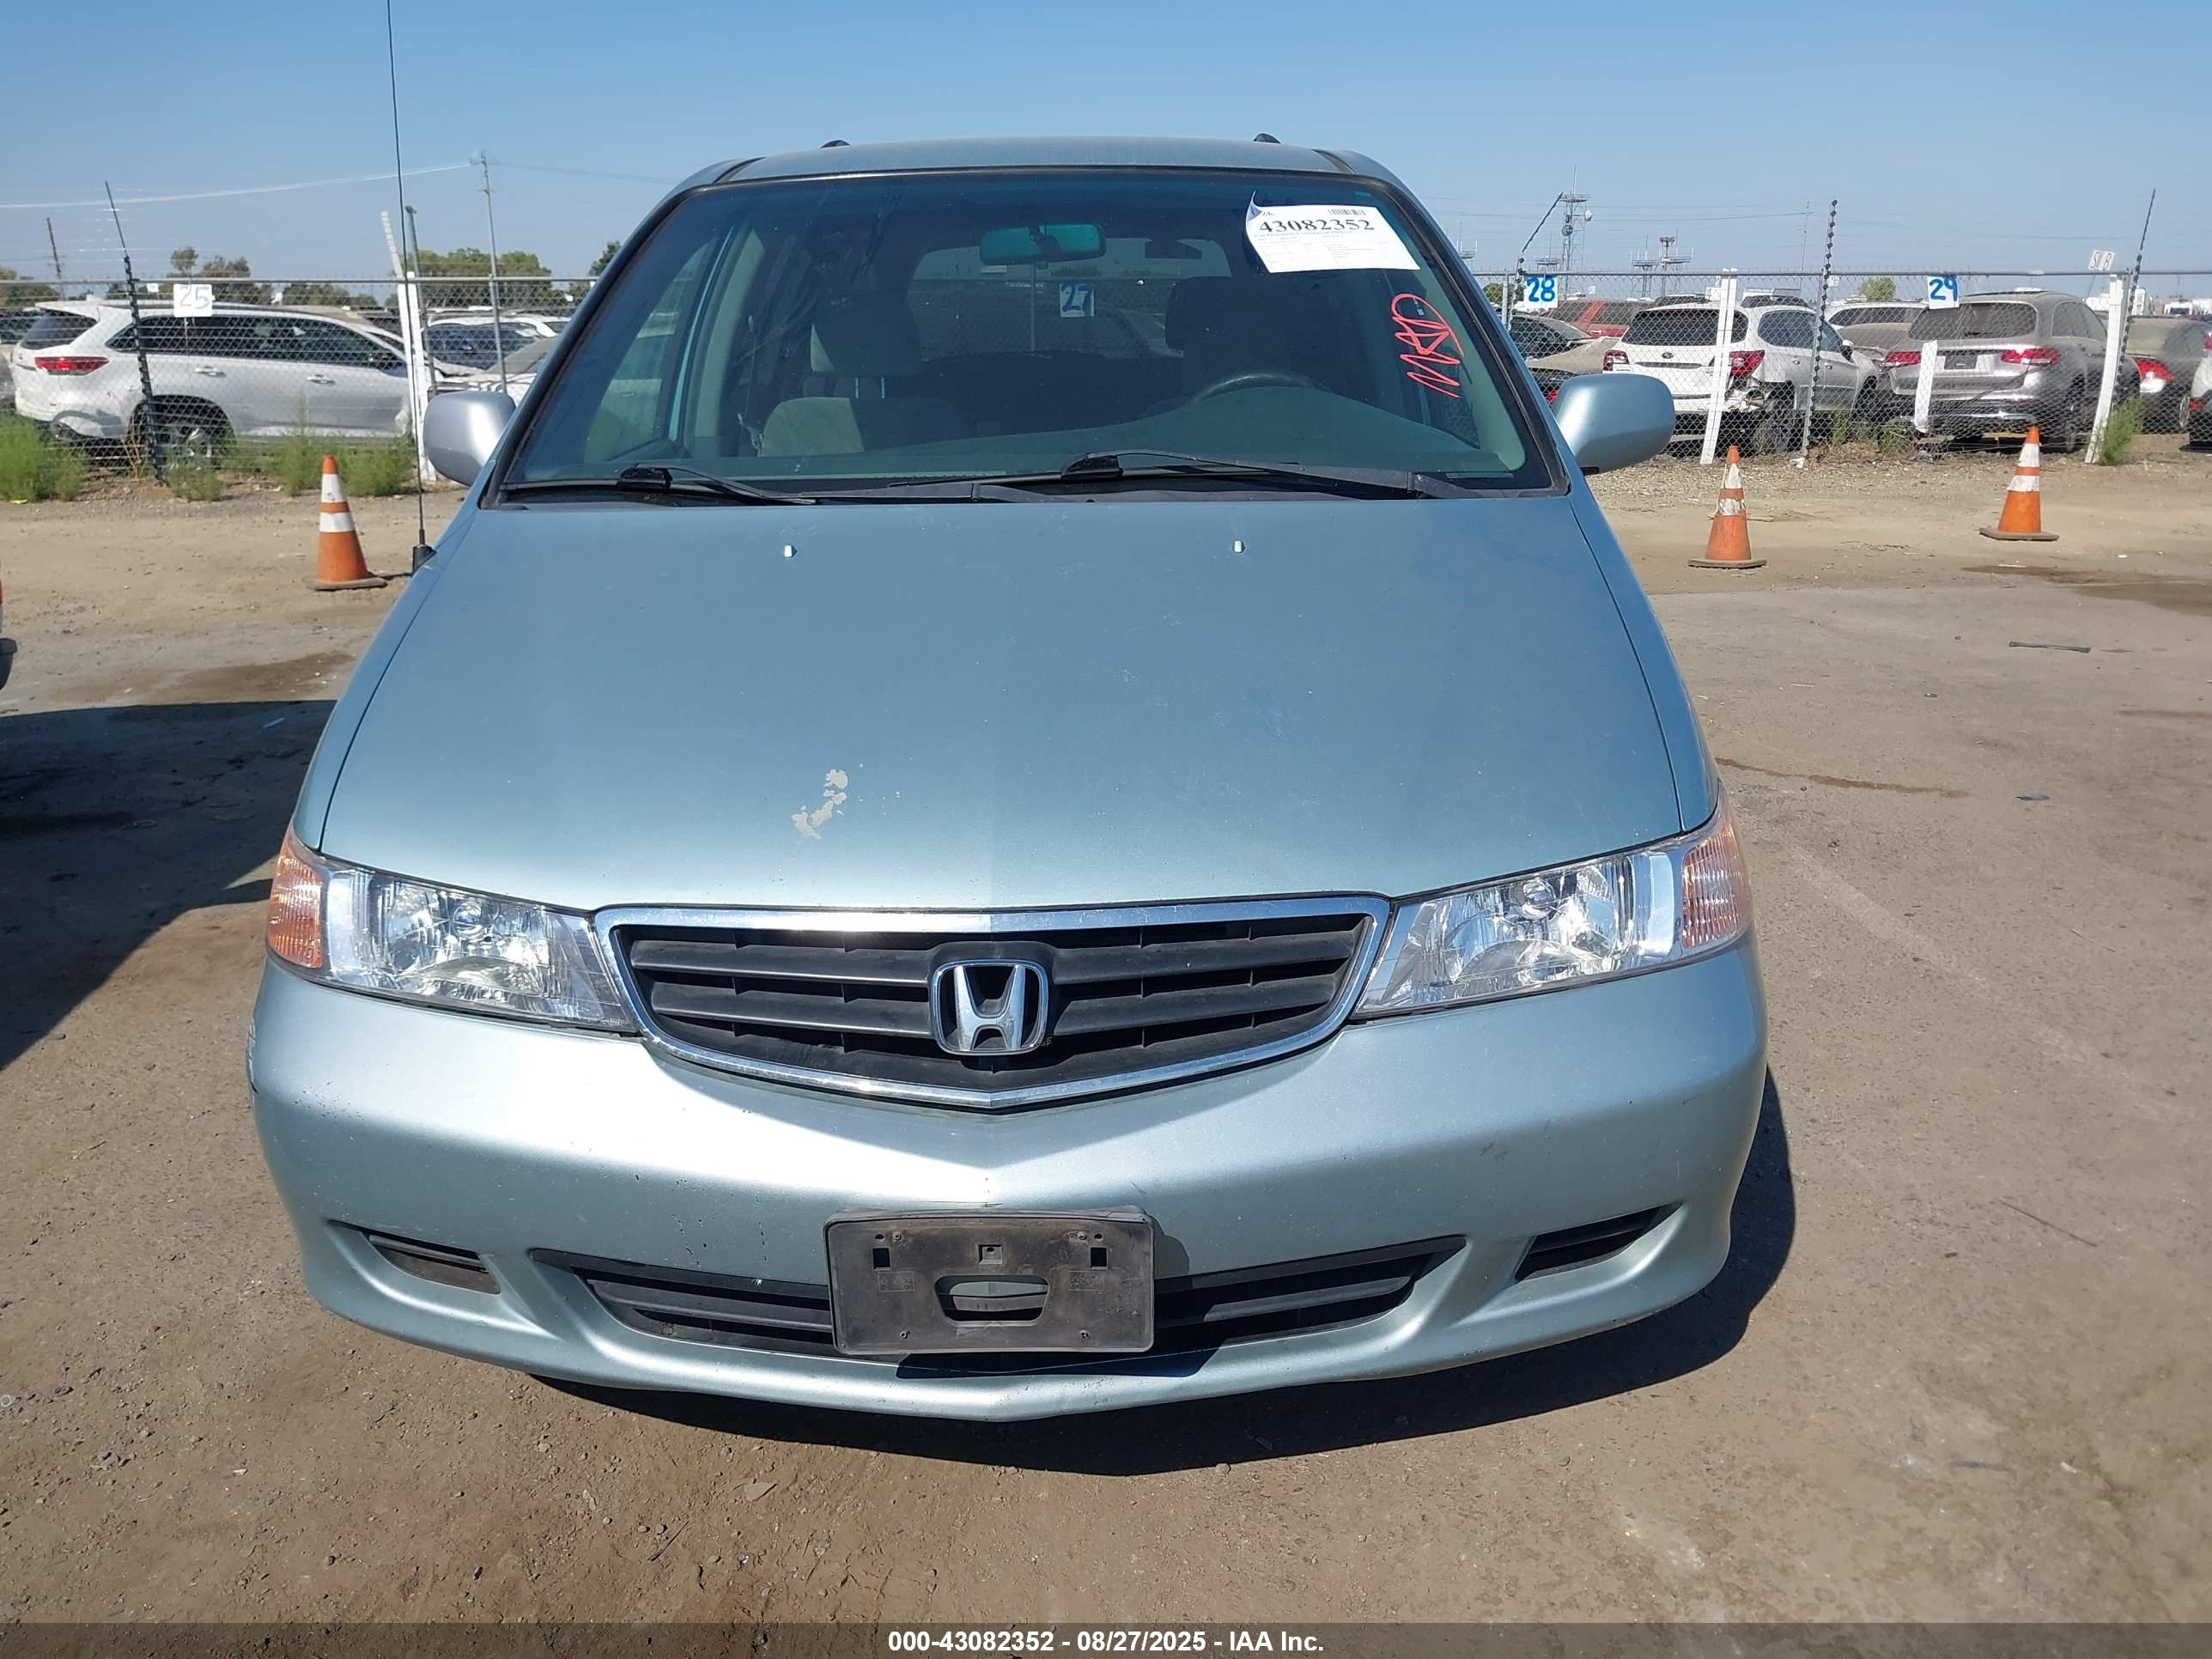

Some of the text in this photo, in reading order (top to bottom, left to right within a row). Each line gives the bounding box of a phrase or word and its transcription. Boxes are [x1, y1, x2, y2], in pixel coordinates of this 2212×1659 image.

[1259, 219, 1375, 233] 43082352
[179, 285, 210, 310] 25
[1061, 283, 1092, 313] 27
[1526, 275, 1556, 302] 28
[1929, 274, 1958, 302] 29
